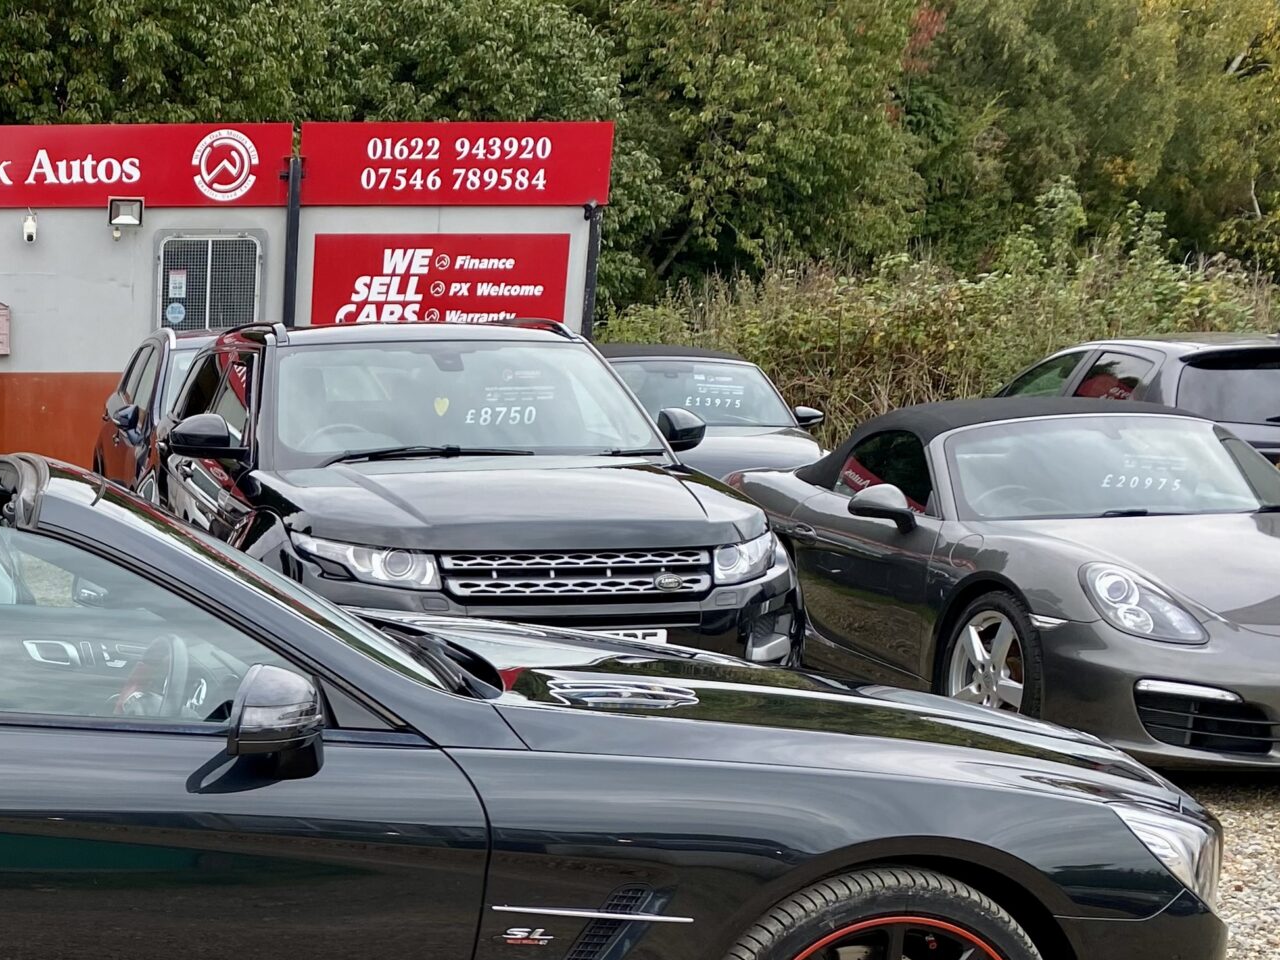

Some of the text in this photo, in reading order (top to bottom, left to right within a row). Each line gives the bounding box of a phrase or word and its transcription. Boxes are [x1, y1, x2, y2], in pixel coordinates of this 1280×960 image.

[367, 136, 552, 161] 01622 943920
[24, 149, 141, 185] Autos
[360, 167, 547, 190] 07546 789584
[383, 248, 434, 275] WE
[454, 255, 516, 270] Finance
[351, 275, 424, 303] SELL
[448, 282, 544, 297] PX Welcome
[445, 310, 517, 322] Warranty
[685, 396, 741, 408] £13975
[465, 406, 536, 425] £8750
[1101, 473, 1182, 491] £20975
[501, 927, 554, 939] SL
